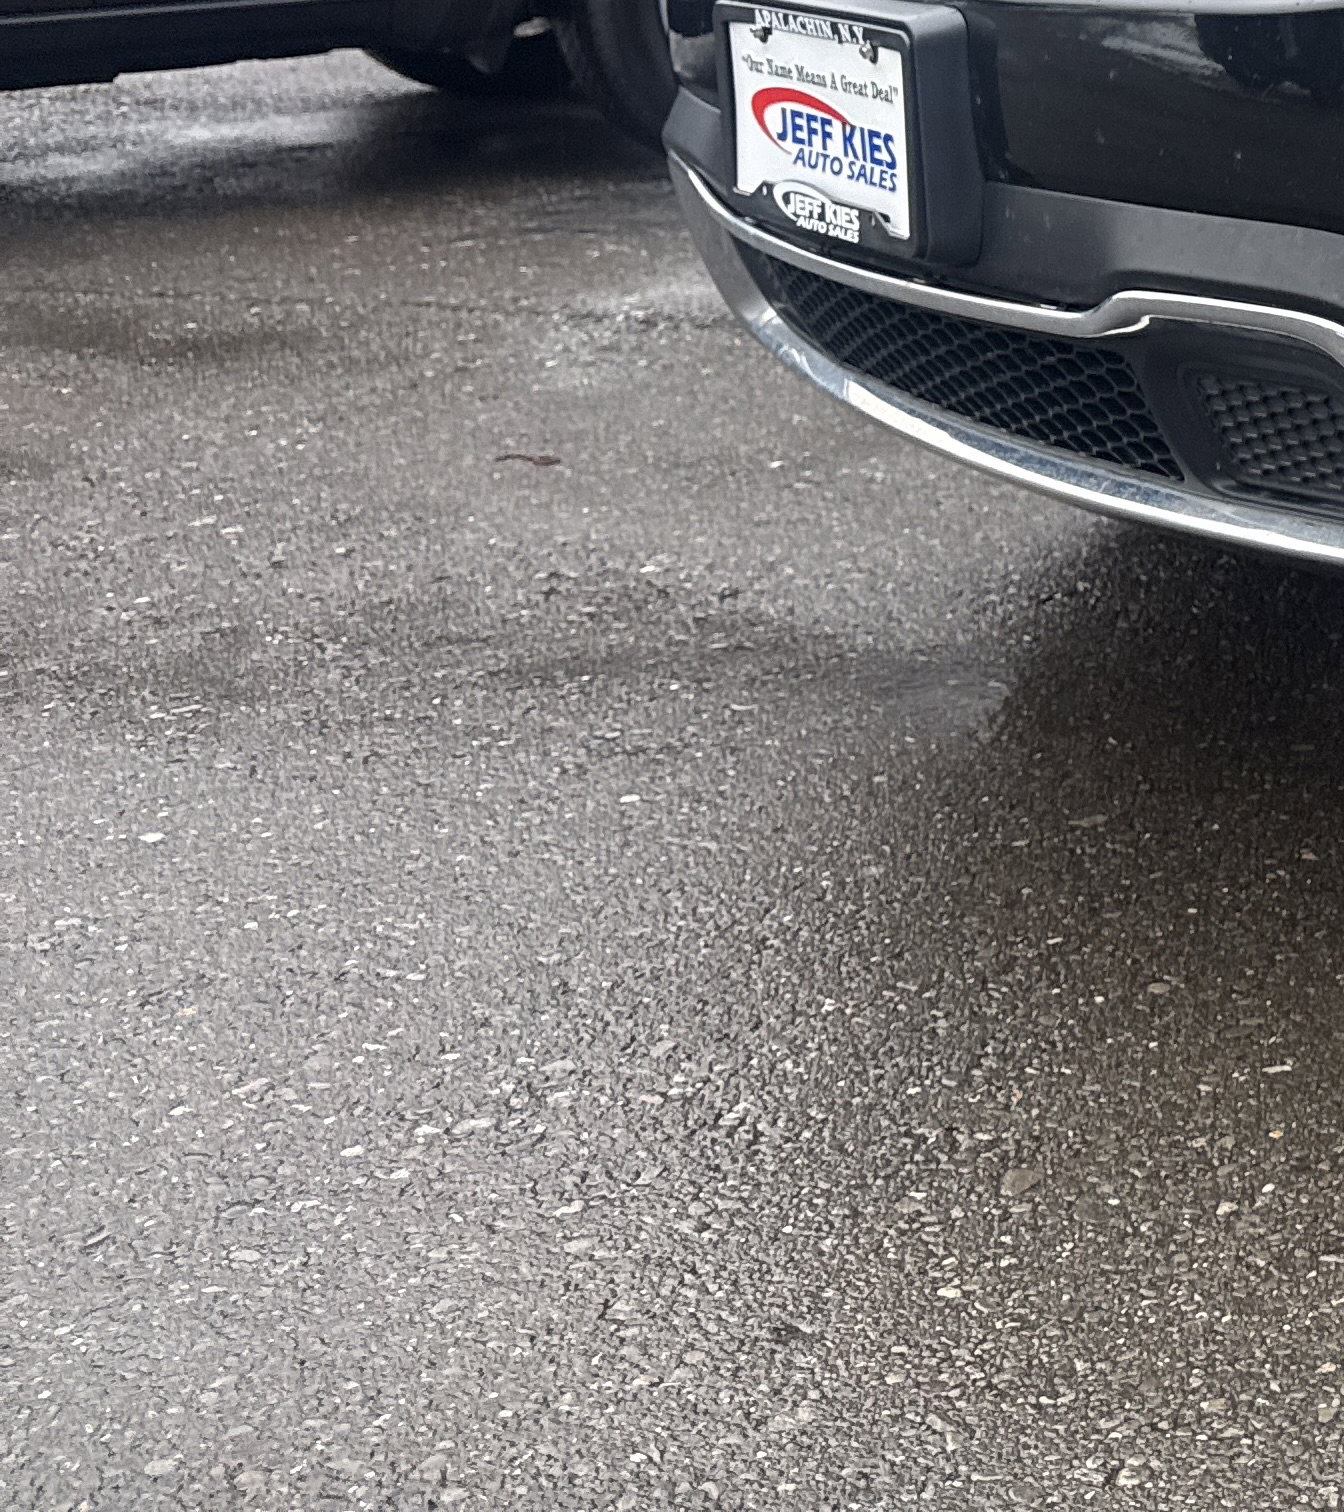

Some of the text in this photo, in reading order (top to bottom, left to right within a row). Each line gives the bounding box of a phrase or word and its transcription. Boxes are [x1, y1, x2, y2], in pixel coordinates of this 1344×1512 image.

[766, 58, 793, 80] Name
[794, 64, 828, 88] Means
[830, 72, 839, 91] A
[840, 74, 869, 98] Great
[776, 107, 897, 170] JEFF KIES
[793, 148, 897, 192] AUTO SALES
[787, 192, 860, 231] JEFF KIES
[796, 216, 860, 244] AUTO SALES
